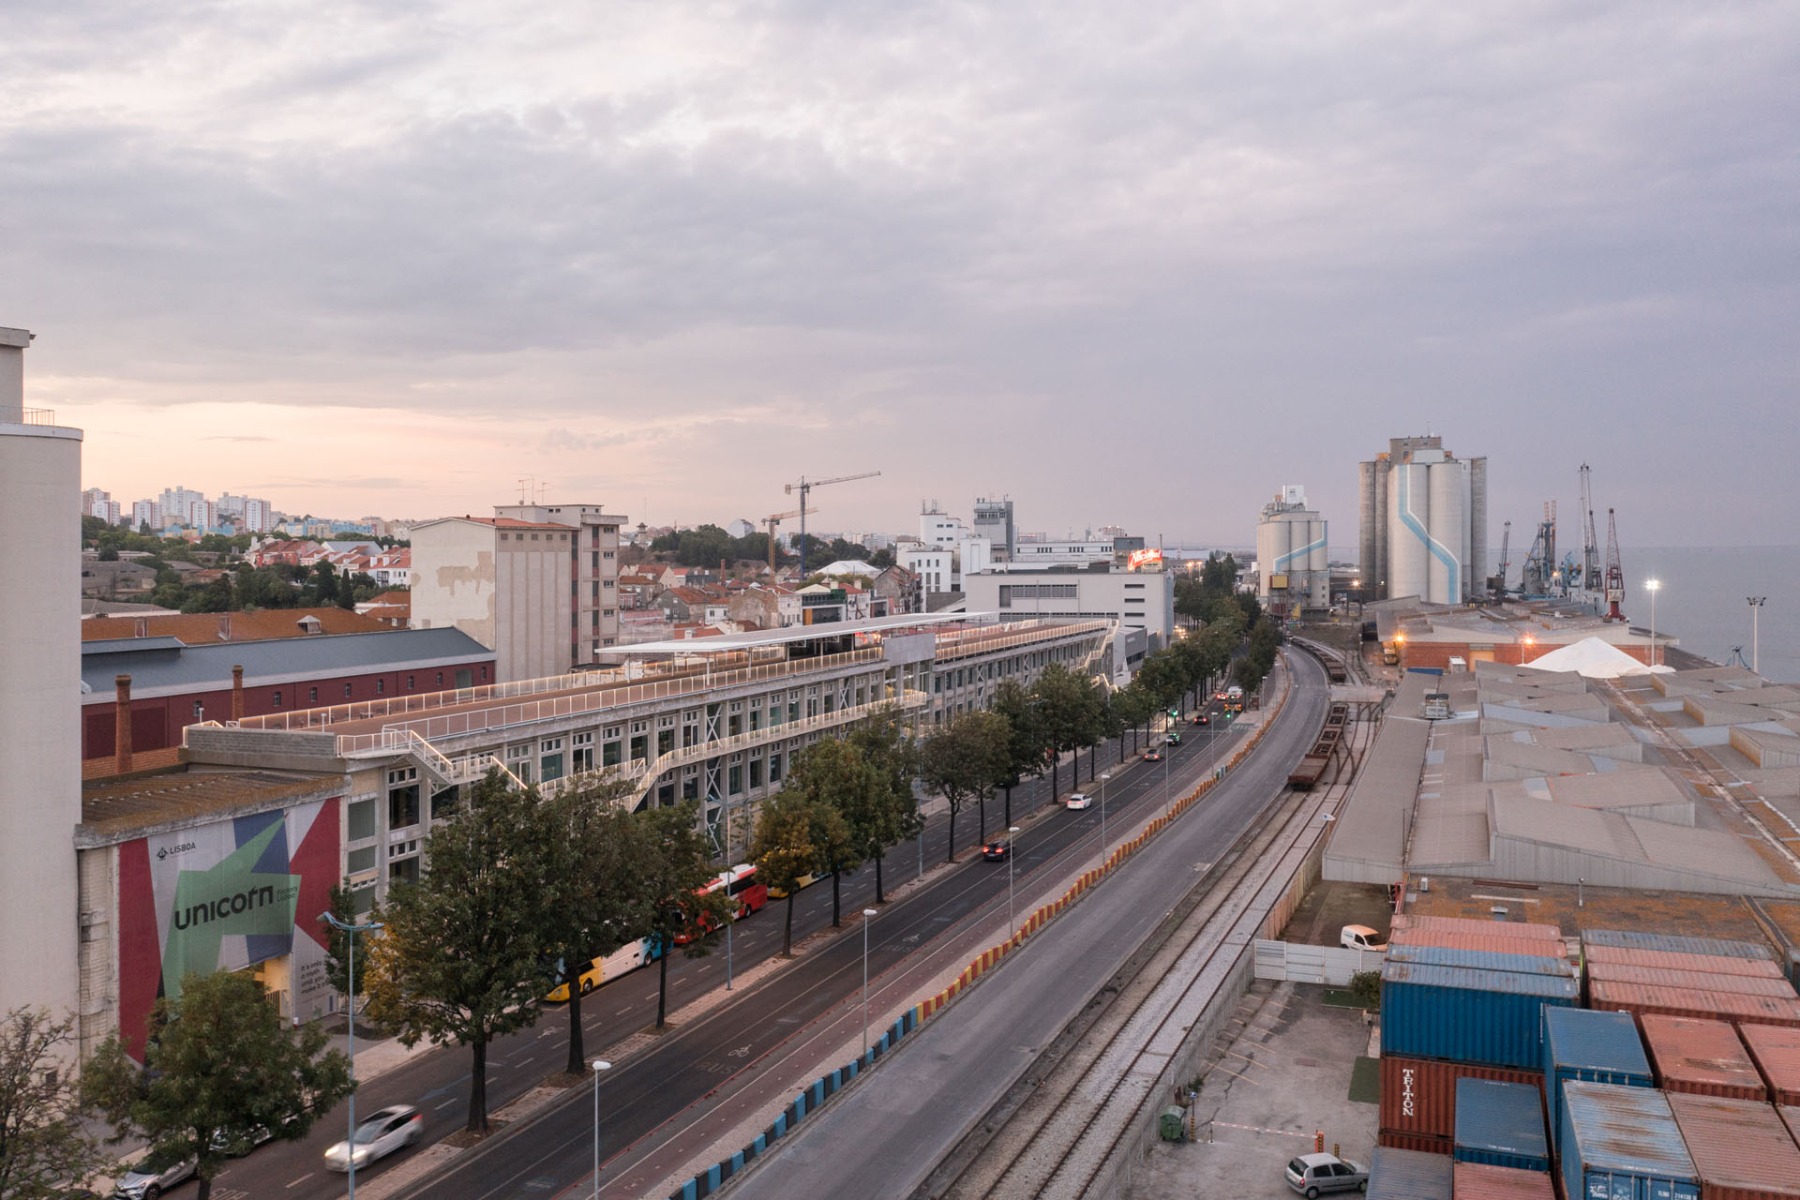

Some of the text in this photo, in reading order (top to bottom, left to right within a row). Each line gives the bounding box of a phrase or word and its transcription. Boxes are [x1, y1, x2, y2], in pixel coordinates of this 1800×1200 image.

[169, 842, 196, 854] LISBOA
[175, 885, 273, 930] unicorn
[1402, 1068, 1414, 1116] TRITON
